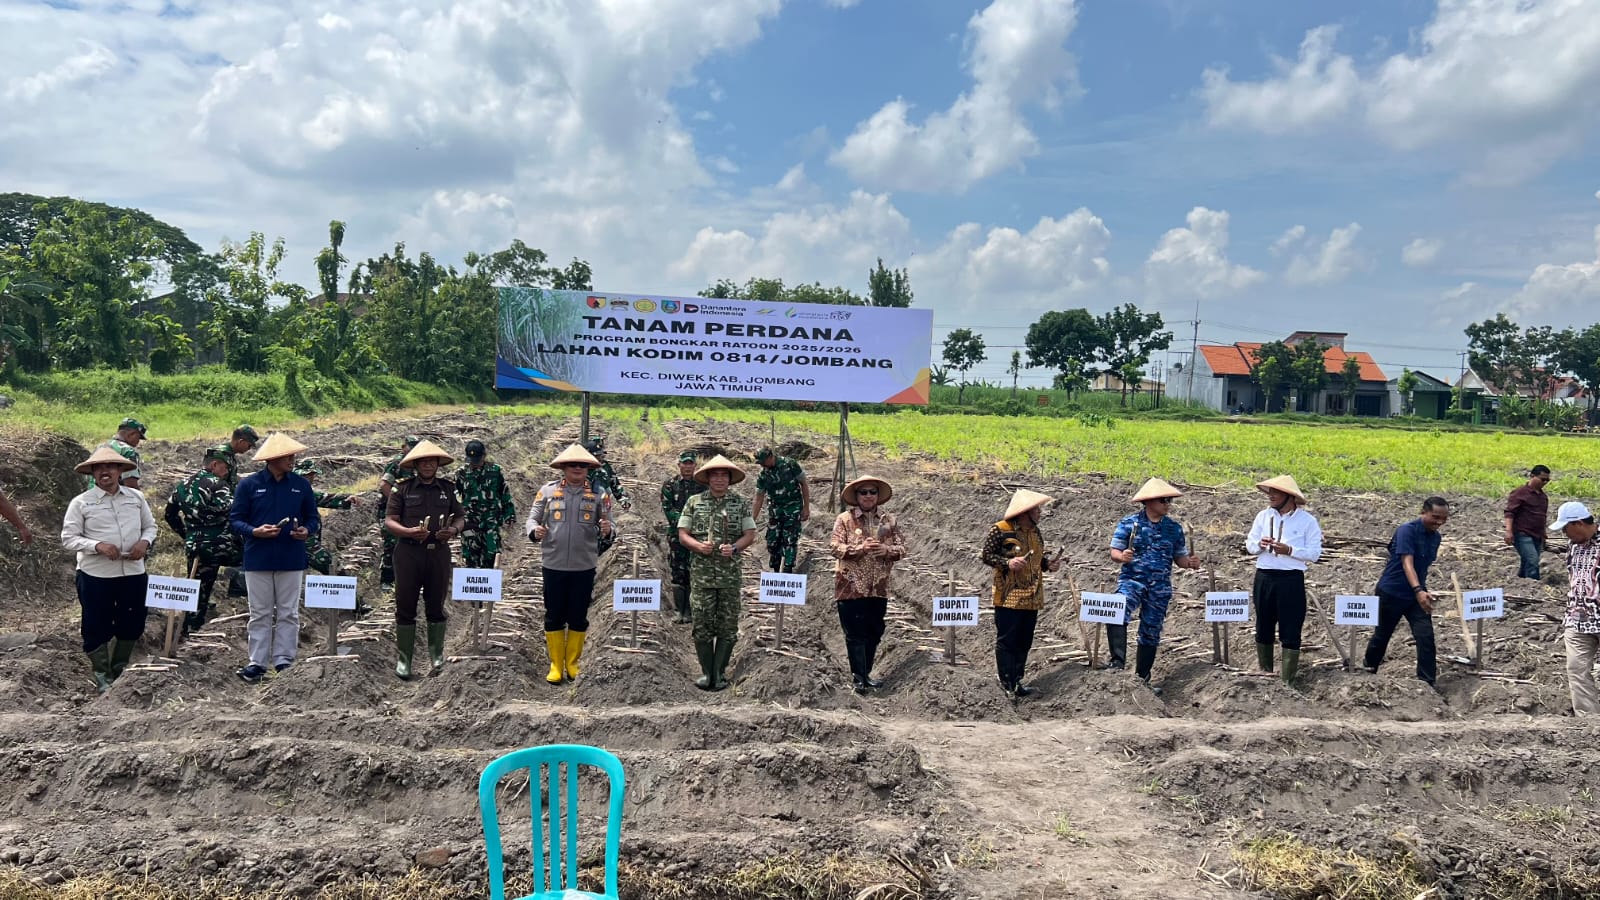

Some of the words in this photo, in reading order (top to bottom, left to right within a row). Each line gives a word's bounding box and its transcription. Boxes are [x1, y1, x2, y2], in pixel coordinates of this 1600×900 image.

[701, 304, 747, 312] Danantara
[582, 315, 695, 335] TANAM
[705, 322, 854, 342] PERDANA
[574, 334, 645, 344] PROGRAM
[650, 338, 718, 347] BONGKAR
[722, 341, 778, 350] RATOON
[782, 344, 861, 354] 2025/2026
[537, 343, 619, 357] LAHAN
[627, 349, 703, 361] KODIM
[711, 351, 893, 369] 0814/JOMBANG
[620, 371, 653, 380] KEC.
[658, 373, 704, 382] DIWEK
[709, 375, 741, 383] KAB.
[746, 376, 815, 386] JOMBANG
[675, 382, 715, 391] JAWA
[722, 384, 763, 392] TIMUR
[466, 576, 489, 584] KAJARI
[172, 586, 196, 594] MANAGER
[462, 586, 492, 595] JOMBANG
[621, 587, 653, 595] KAPOLRES
[766, 589, 796, 597] JOMBANG
[622, 596, 652, 604] JOMBANG
[1083, 599, 1101, 607] WAKIL
[1102, 600, 1124, 609] BUPATI
[939, 600, 969, 610] BUPATI
[1347, 602, 1366, 610] SEKDA
[1471, 605, 1496, 613] JOMBANG
[934, 612, 973, 622] JOMBANG
[1088, 609, 1116, 617] JOMBANG
[1342, 611, 1370, 619] JOMBANG
